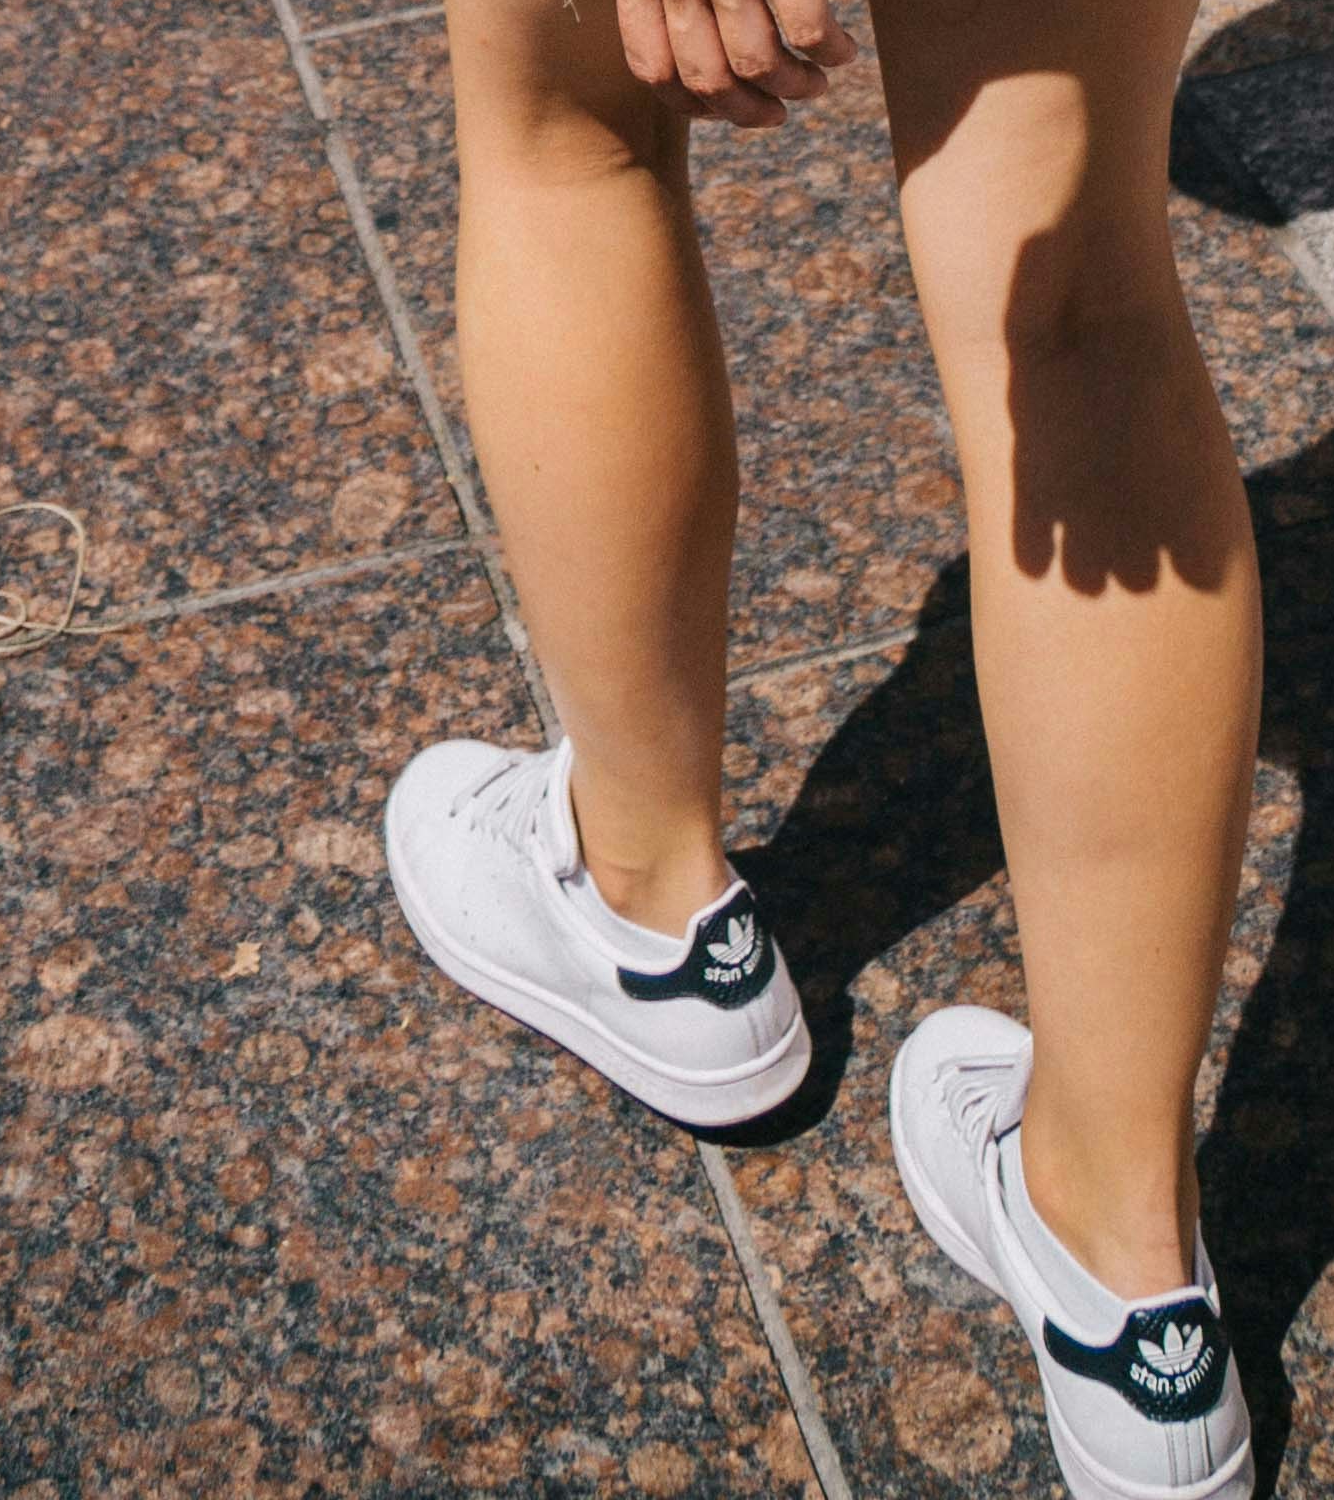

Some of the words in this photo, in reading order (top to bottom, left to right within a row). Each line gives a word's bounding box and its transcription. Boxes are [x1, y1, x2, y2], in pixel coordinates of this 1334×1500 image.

[704, 965, 743, 983] stan
[1130, 1362, 1170, 1396] stan
[1174, 1345, 1215, 1395] smith
